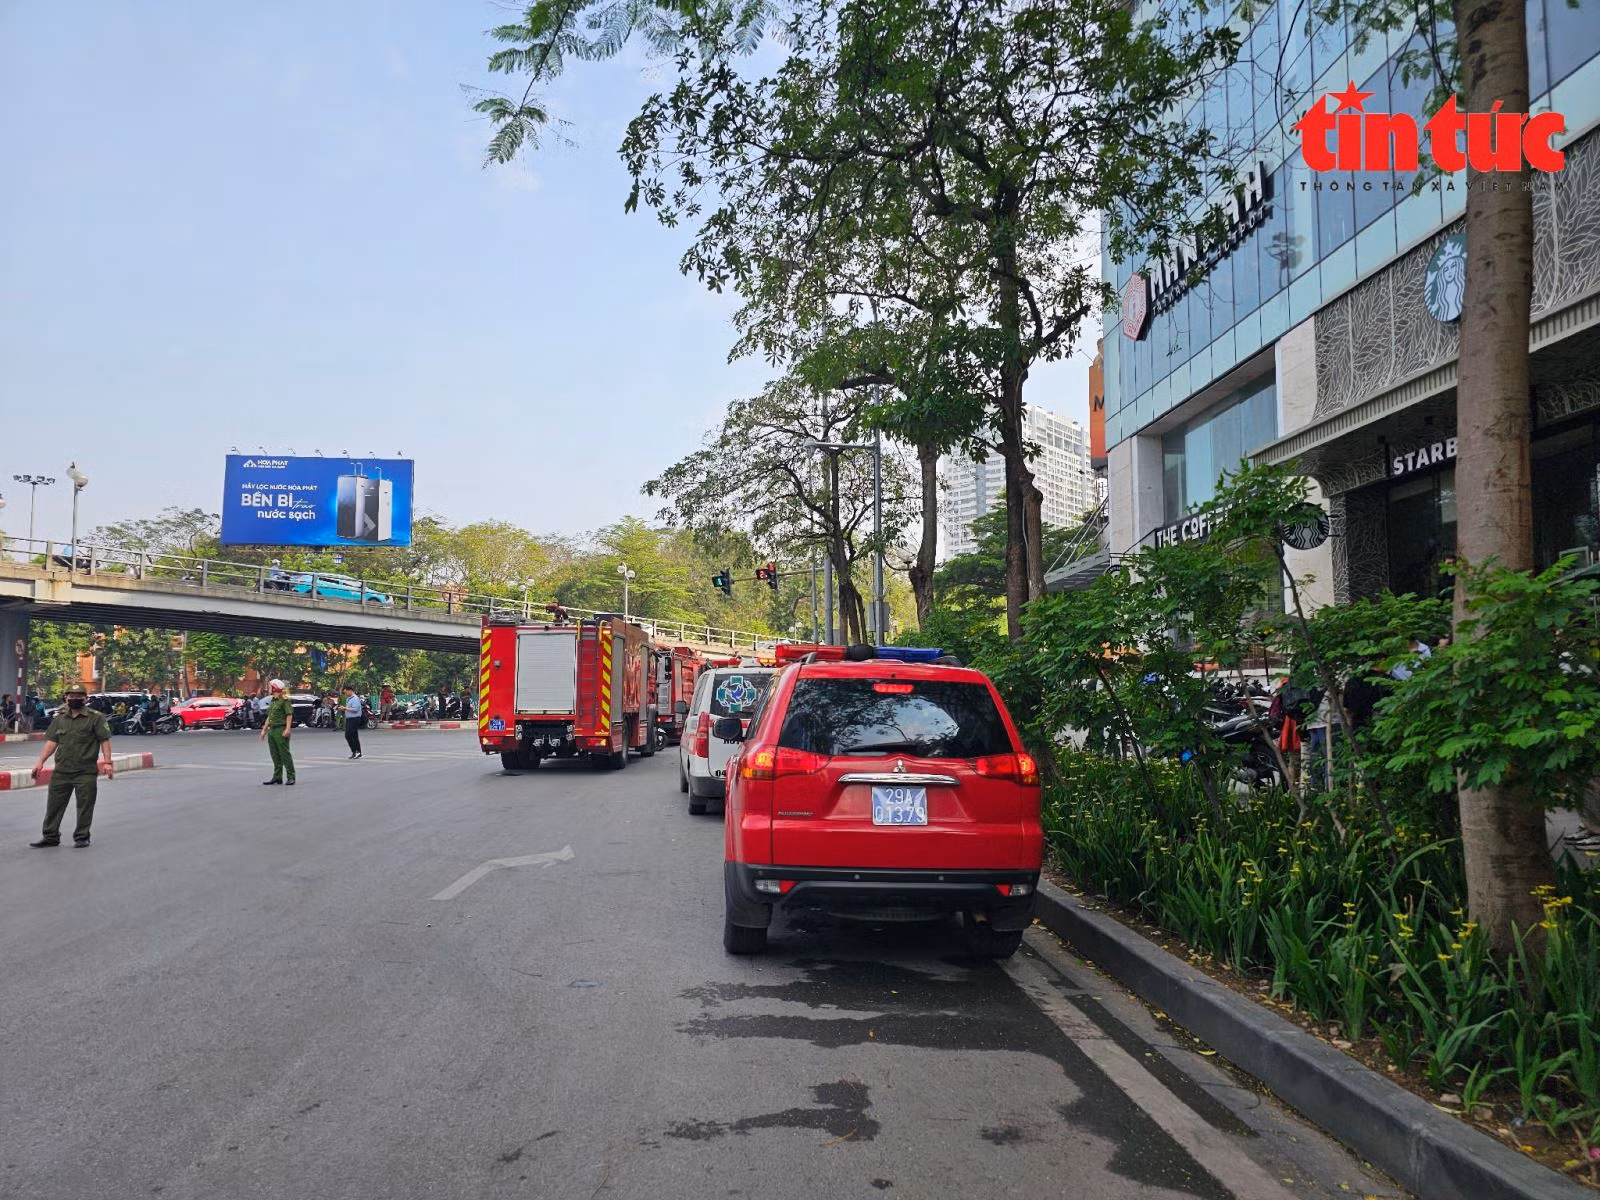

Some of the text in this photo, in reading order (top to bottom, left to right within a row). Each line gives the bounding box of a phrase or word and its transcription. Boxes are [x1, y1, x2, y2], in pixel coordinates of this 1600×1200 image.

[1393, 437, 1458, 475] STARB
[257, 508, 316, 522] nước sạch
[1156, 526, 1179, 549] THE
[885, 788, 913, 805] 29A
